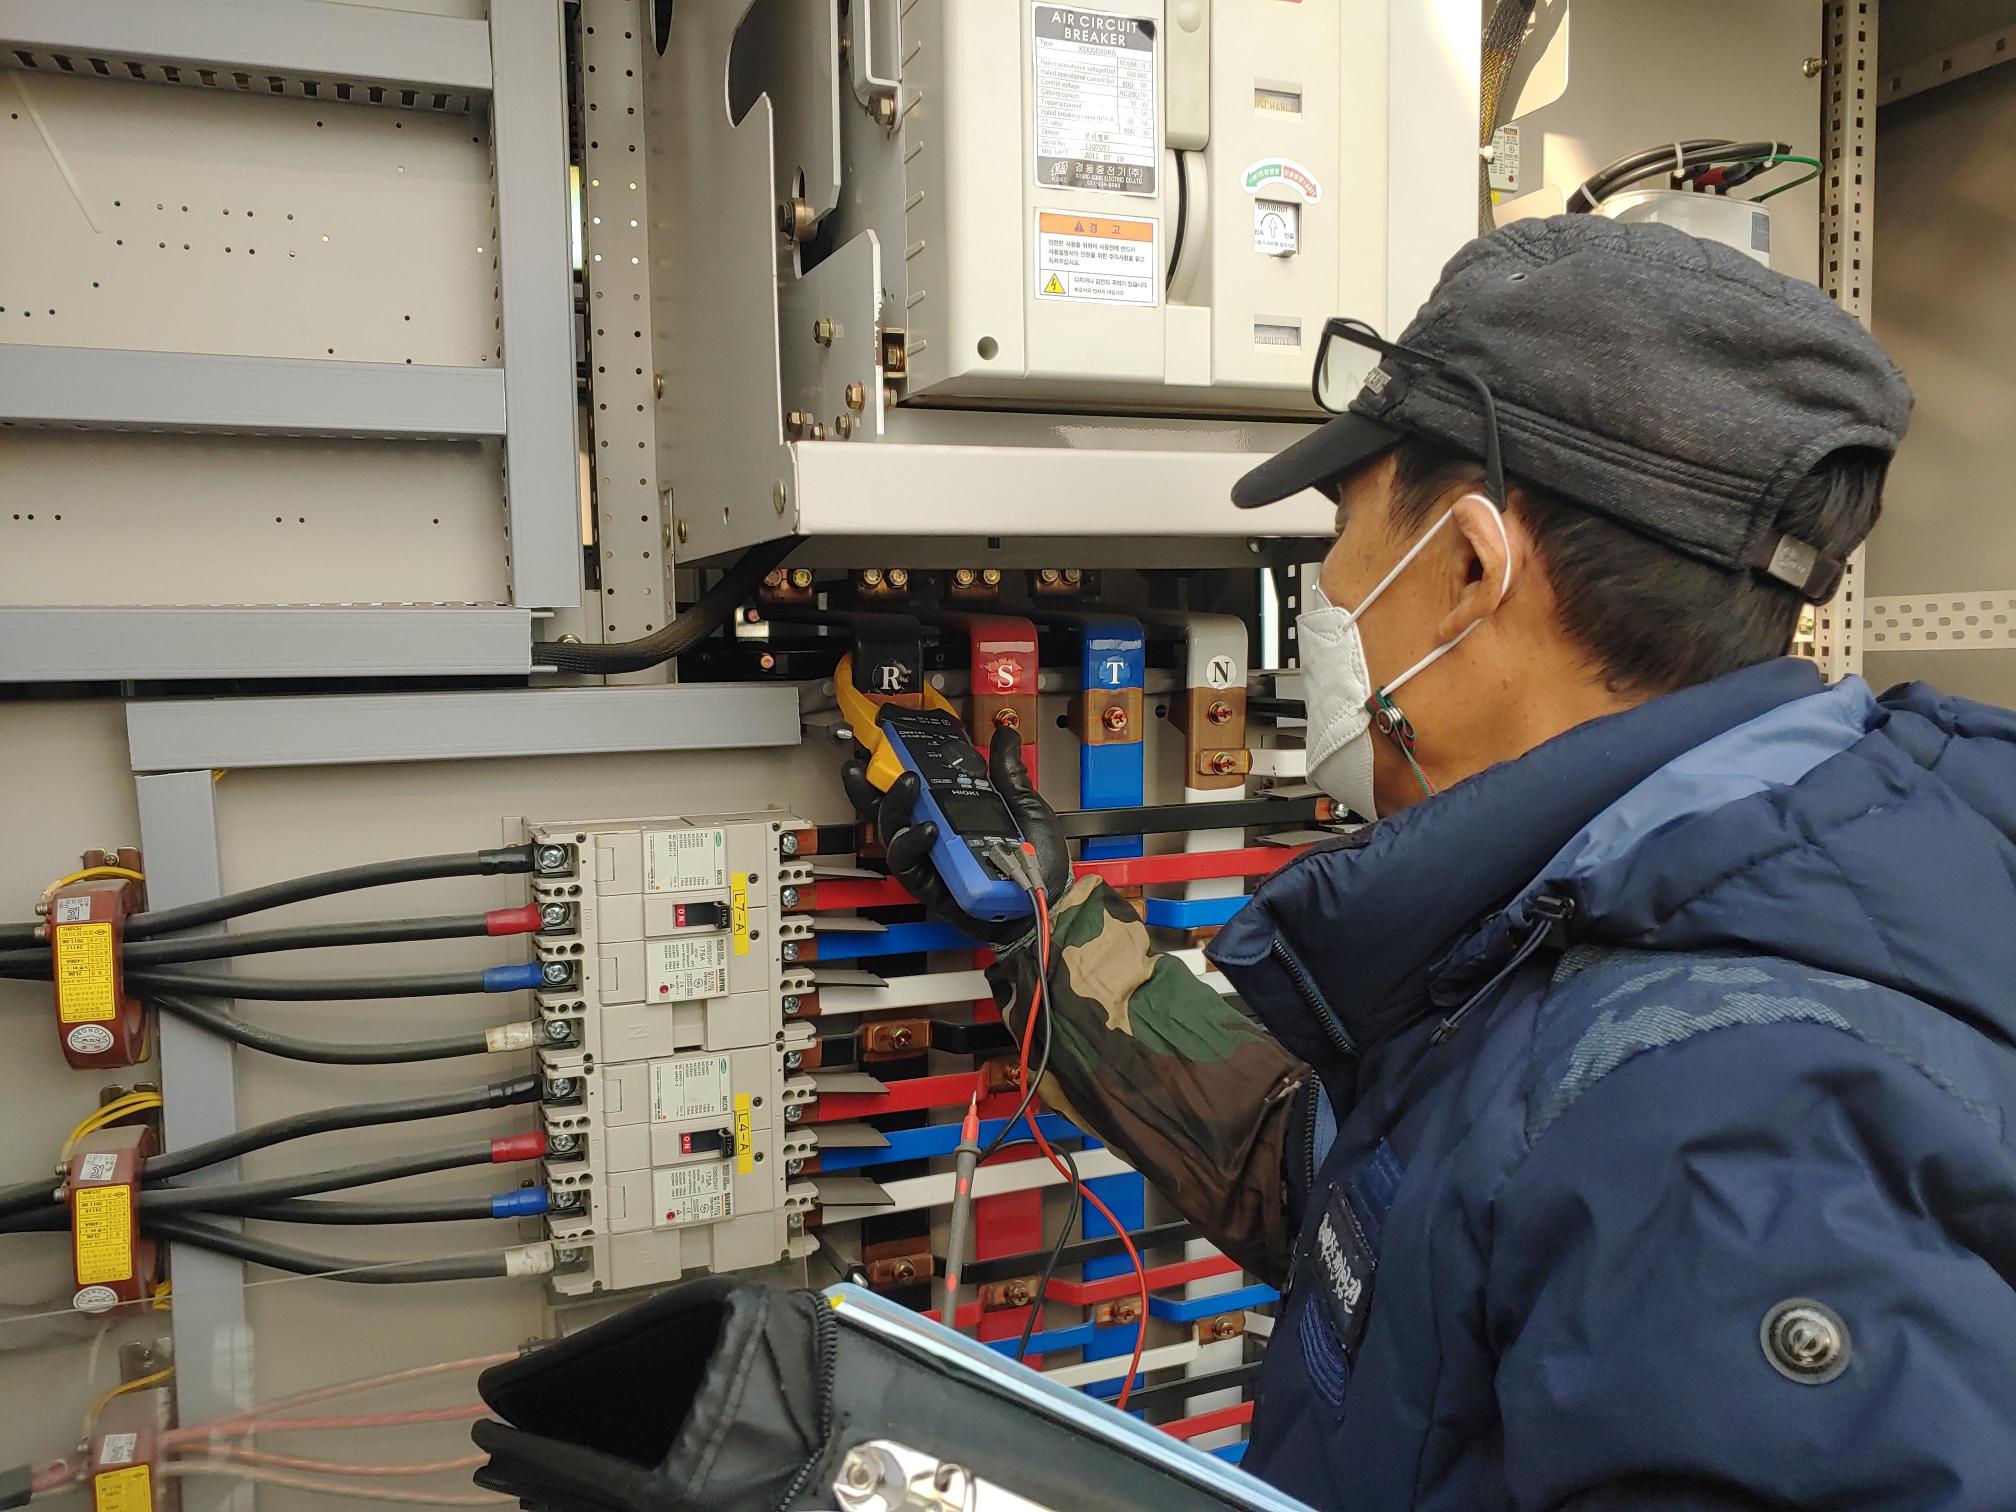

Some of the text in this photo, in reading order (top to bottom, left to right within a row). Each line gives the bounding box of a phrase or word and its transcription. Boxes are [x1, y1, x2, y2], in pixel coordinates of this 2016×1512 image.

[1051, 11, 1138, 34] AIR CIRCUIT
[1064, 27, 1126, 47] BREAKER
[1111, 225, 1121, 235] 고
[881, 666, 902, 690] R
[998, 664, 1015, 689] S
[1107, 661, 1124, 685] T
[1212, 661, 1230, 683] N
[952, 789, 980, 797] HIOKI
[678, 908, 687, 925] ON
[720, 906, 729, 927] 175A
[734, 893, 747, 932] L7-A
[683, 1136, 692, 1150] ON
[738, 1113, 751, 1154] L4-A
